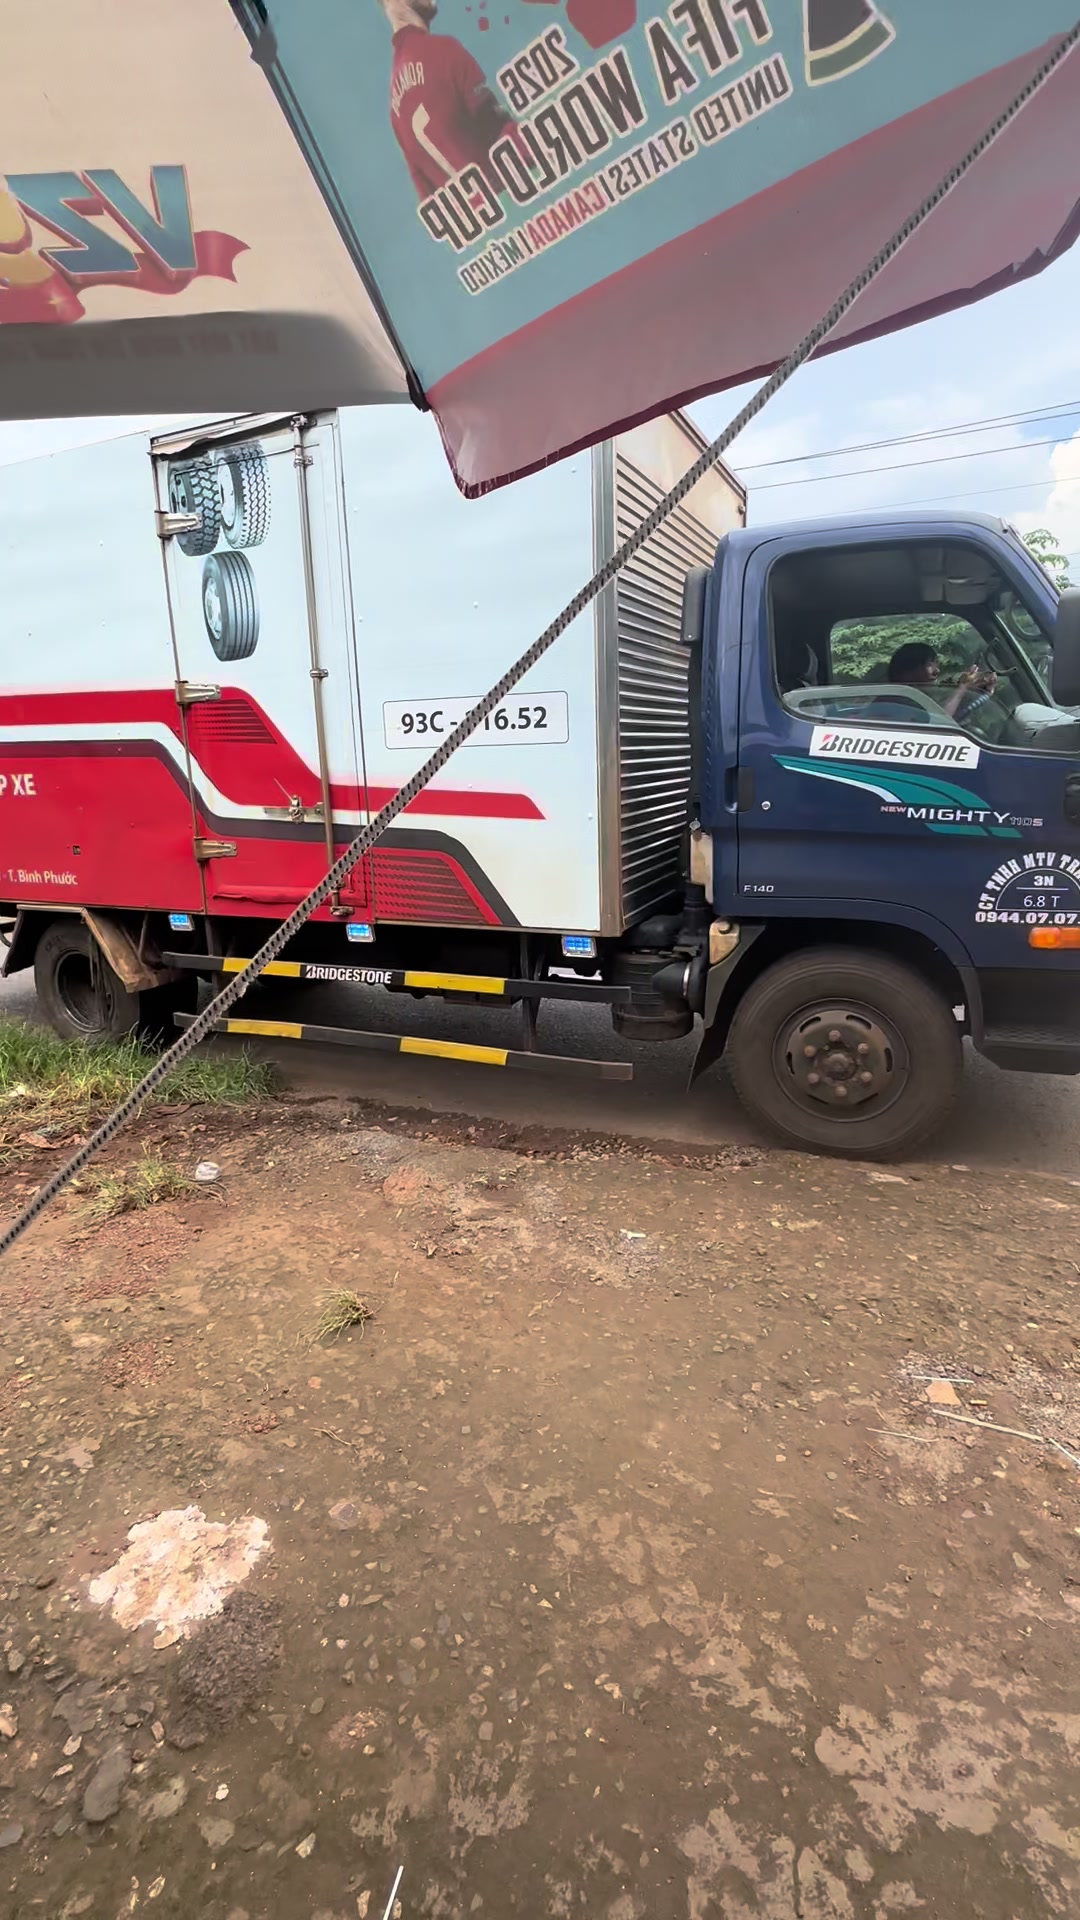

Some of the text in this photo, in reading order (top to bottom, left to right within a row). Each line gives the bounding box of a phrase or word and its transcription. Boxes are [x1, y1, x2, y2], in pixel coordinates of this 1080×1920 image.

[401, 710, 445, 735] 93C
[465, 706, 548, 731] 16.52
[819, 733, 971, 763] BRIDGESTONE
[11, 773, 37, 796] XE
[880, 805, 1044, 827] NEW MIGHTY 110S
[1022, 852, 1056, 869] MTV
[985, 858, 1022, 892] TNHH
[1033, 875, 1054, 887] 3N
[978, 892, 996, 911] CT
[1023, 895, 1061, 908] 6.8 T
[305, 964, 393, 985] BRIDGESTONE
